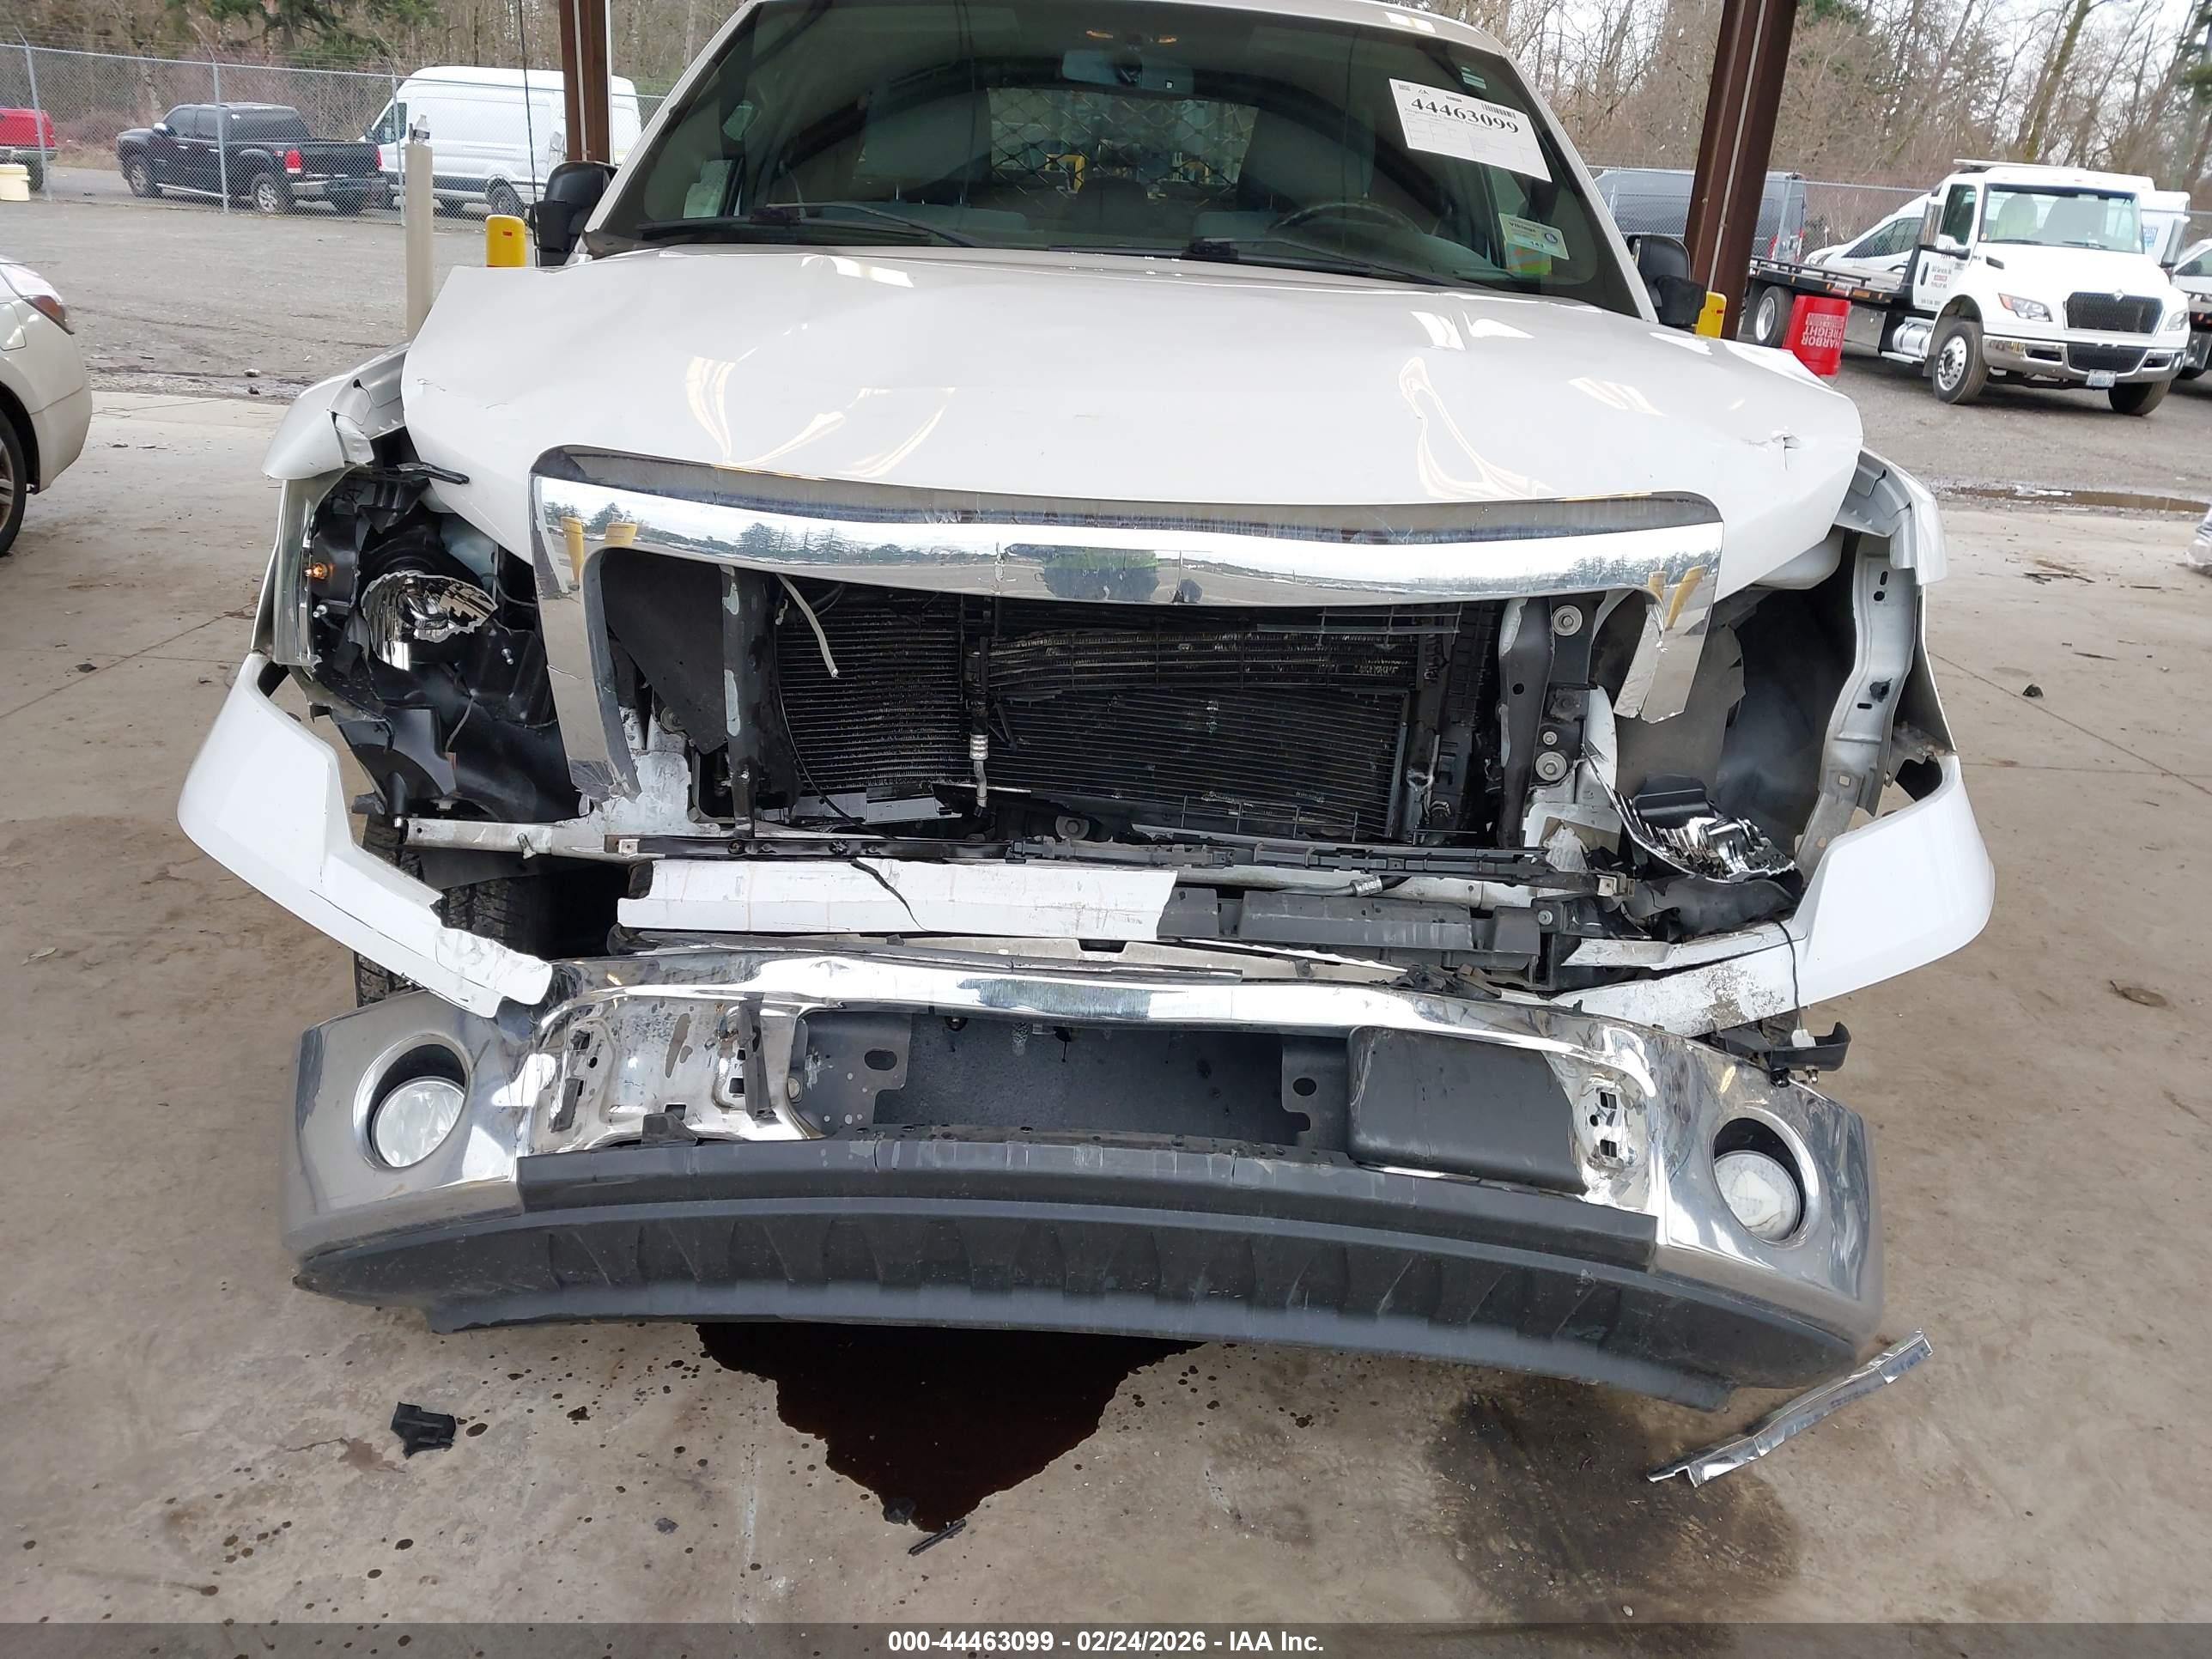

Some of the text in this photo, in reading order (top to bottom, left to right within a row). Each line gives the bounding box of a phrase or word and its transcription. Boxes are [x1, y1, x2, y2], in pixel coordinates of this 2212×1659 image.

[1411, 98, 1519, 133] 44463099
[1802, 325, 1843, 338] FREIGHT
[1801, 334, 1841, 349] HARBOR
